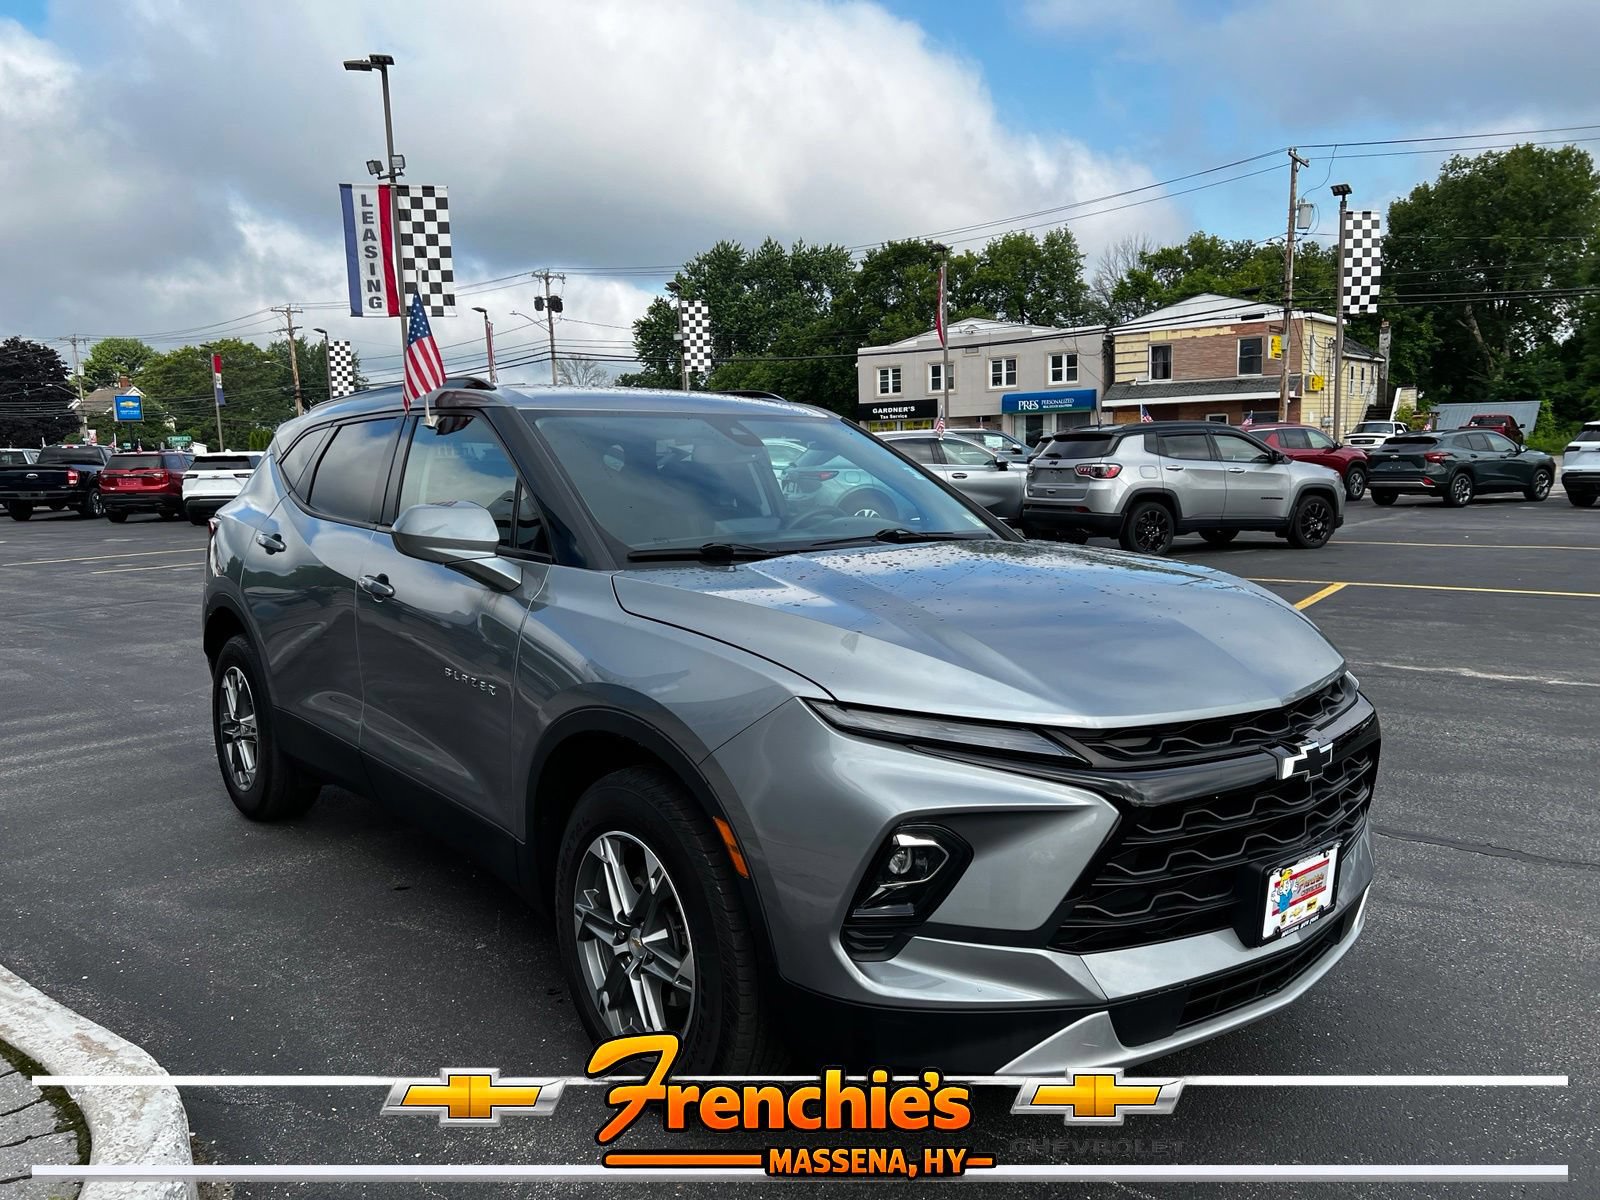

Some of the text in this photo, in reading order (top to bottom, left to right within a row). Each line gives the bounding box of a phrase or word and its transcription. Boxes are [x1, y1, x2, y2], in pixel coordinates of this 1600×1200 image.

[360, 193, 383, 309] LEASING
[872, 405, 916, 414] GARDNER'S
[1018, 400, 1039, 411] PRES
[444, 667, 496, 696] BLAZER
